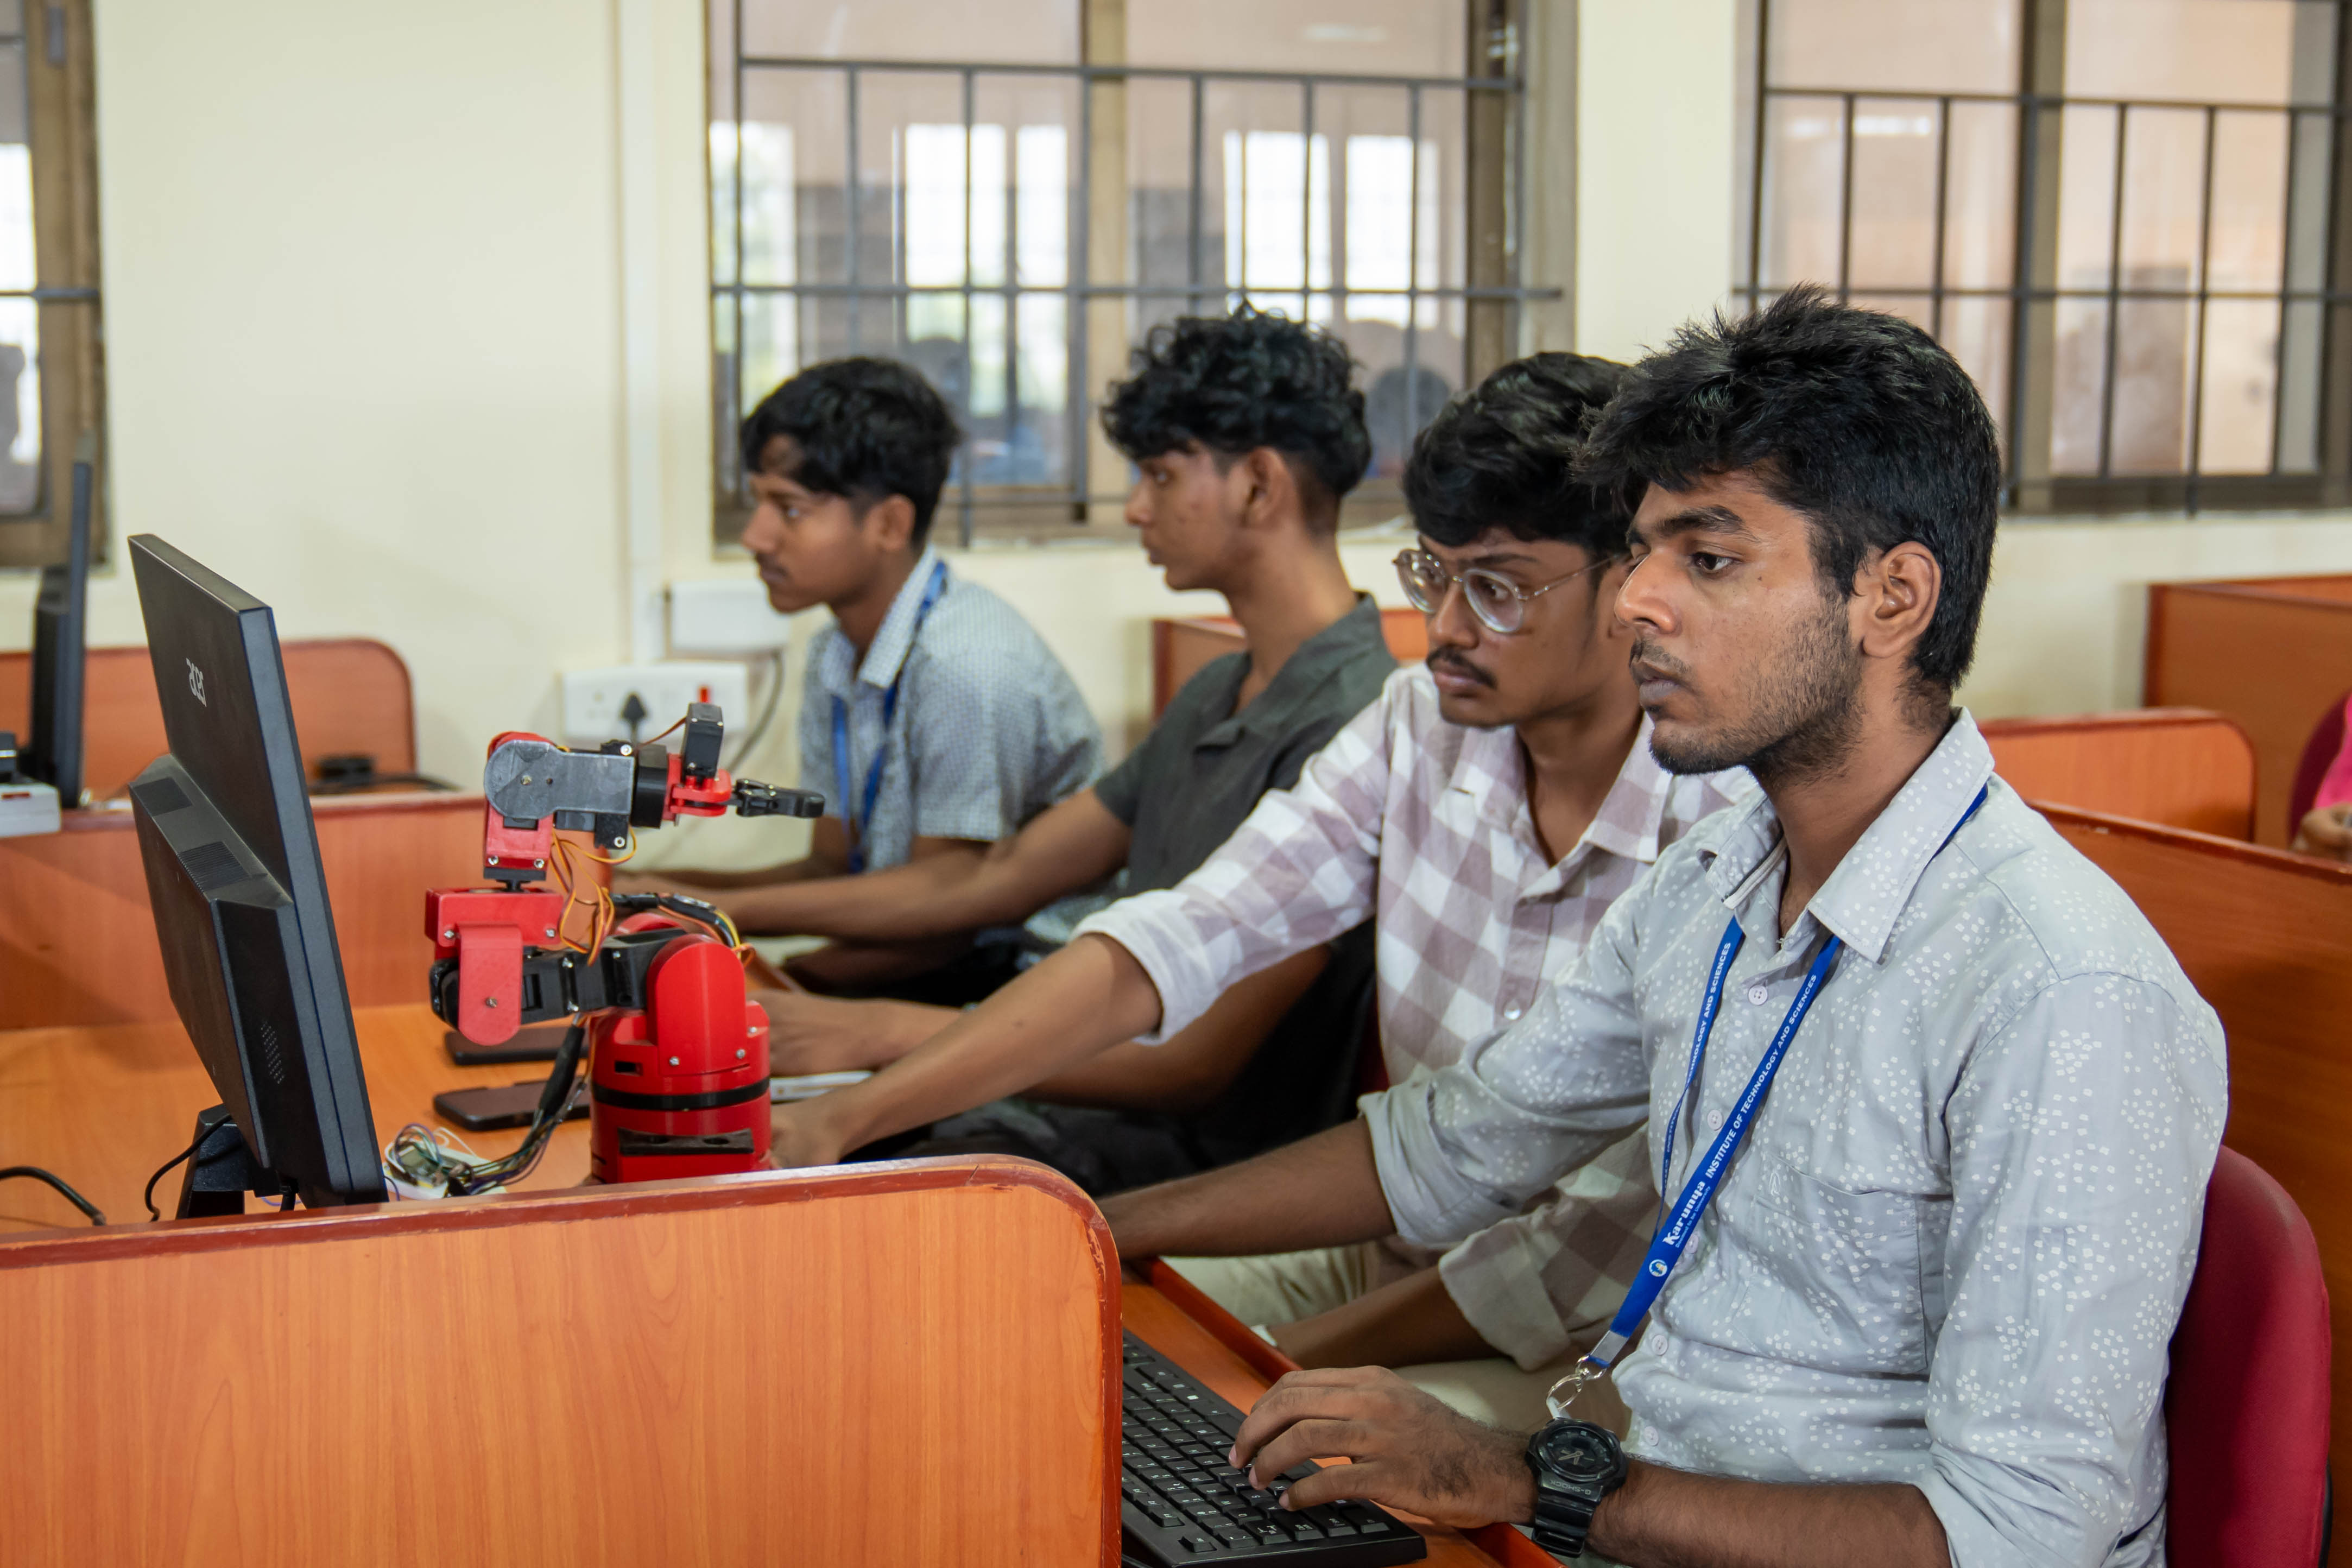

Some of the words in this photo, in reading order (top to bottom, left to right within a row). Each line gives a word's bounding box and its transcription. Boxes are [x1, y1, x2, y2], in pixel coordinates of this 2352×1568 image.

[186, 657, 207, 707] acer
[1704, 995, 1714, 1018] AND
[1710, 943, 1731, 993] SCIENCES
[1662, 1181, 1705, 1245] Karunya
[1705, 1129, 1736, 1179] INSTITUTE
[1733, 1114, 1743, 1129] OF
[1741, 1048, 1779, 1114] TECHNOLOGY
[1778, 1026, 1790, 1048] AND
[1789, 974, 1817, 1025] SCIENCES
[1550, 1480, 1591, 1495] G-SHOCK
